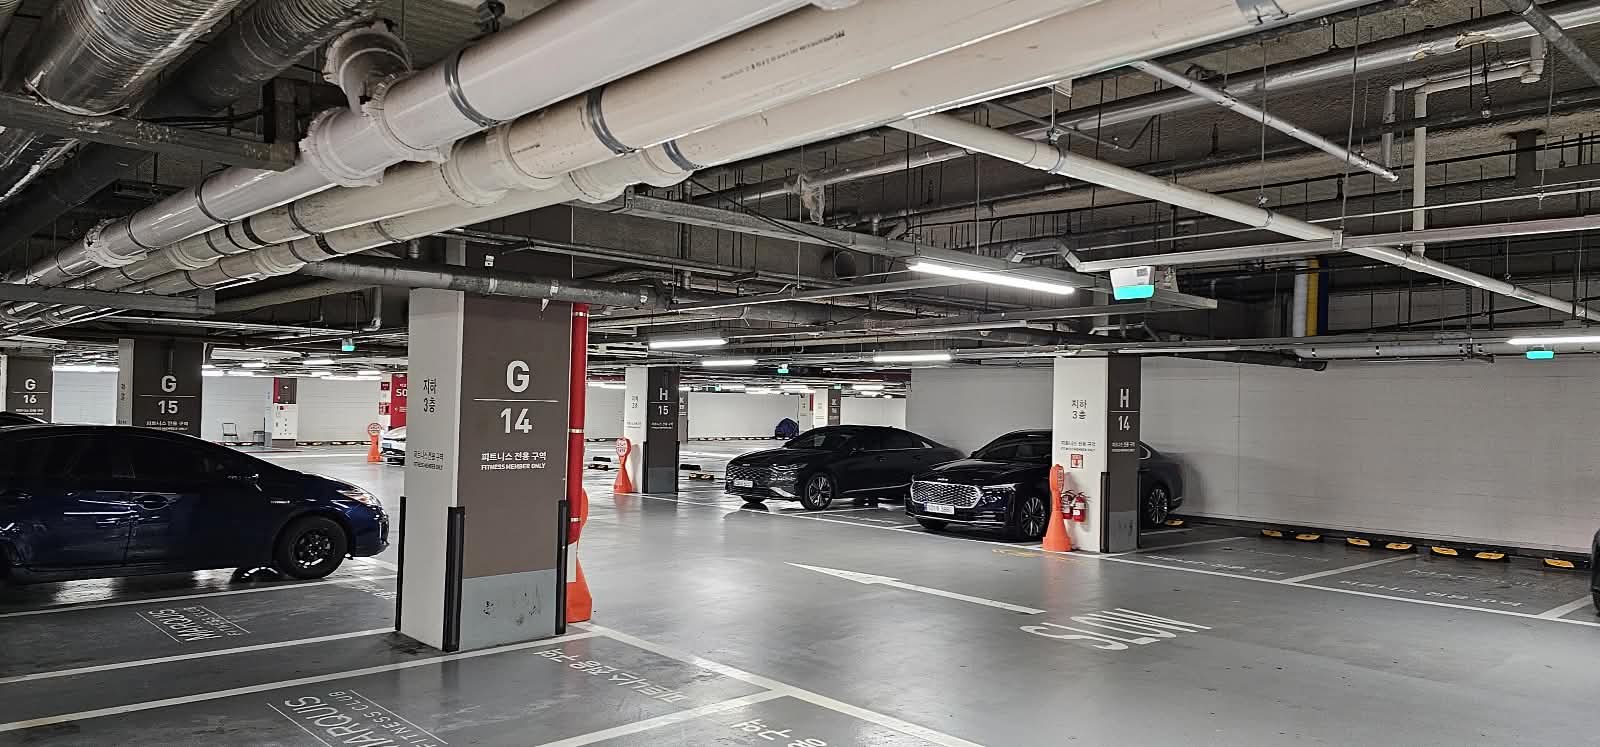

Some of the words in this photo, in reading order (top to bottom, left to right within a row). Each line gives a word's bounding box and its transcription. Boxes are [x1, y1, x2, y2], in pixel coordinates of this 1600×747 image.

[25, 378, 37, 391] G
[161, 375, 177, 393] G
[506, 360, 530, 393] G
[423, 378, 437, 395] 지하
[660, 387, 669, 401] H
[23, 394, 37, 404] 16
[423, 397, 436, 413] 3층
[1120, 388, 1130, 408] H
[158, 400, 178, 414] 15
[658, 405, 669, 415] 15
[500, 407, 533, 434] 14
[1118, 415, 1130, 431] 14
[481, 451, 513, 461] 피트니스
[514, 451, 531, 461] 전용
[531, 451, 547, 461] 구역
[1019, 607, 1213, 650] SLOW
[328, 690, 369, 712] CLUB
